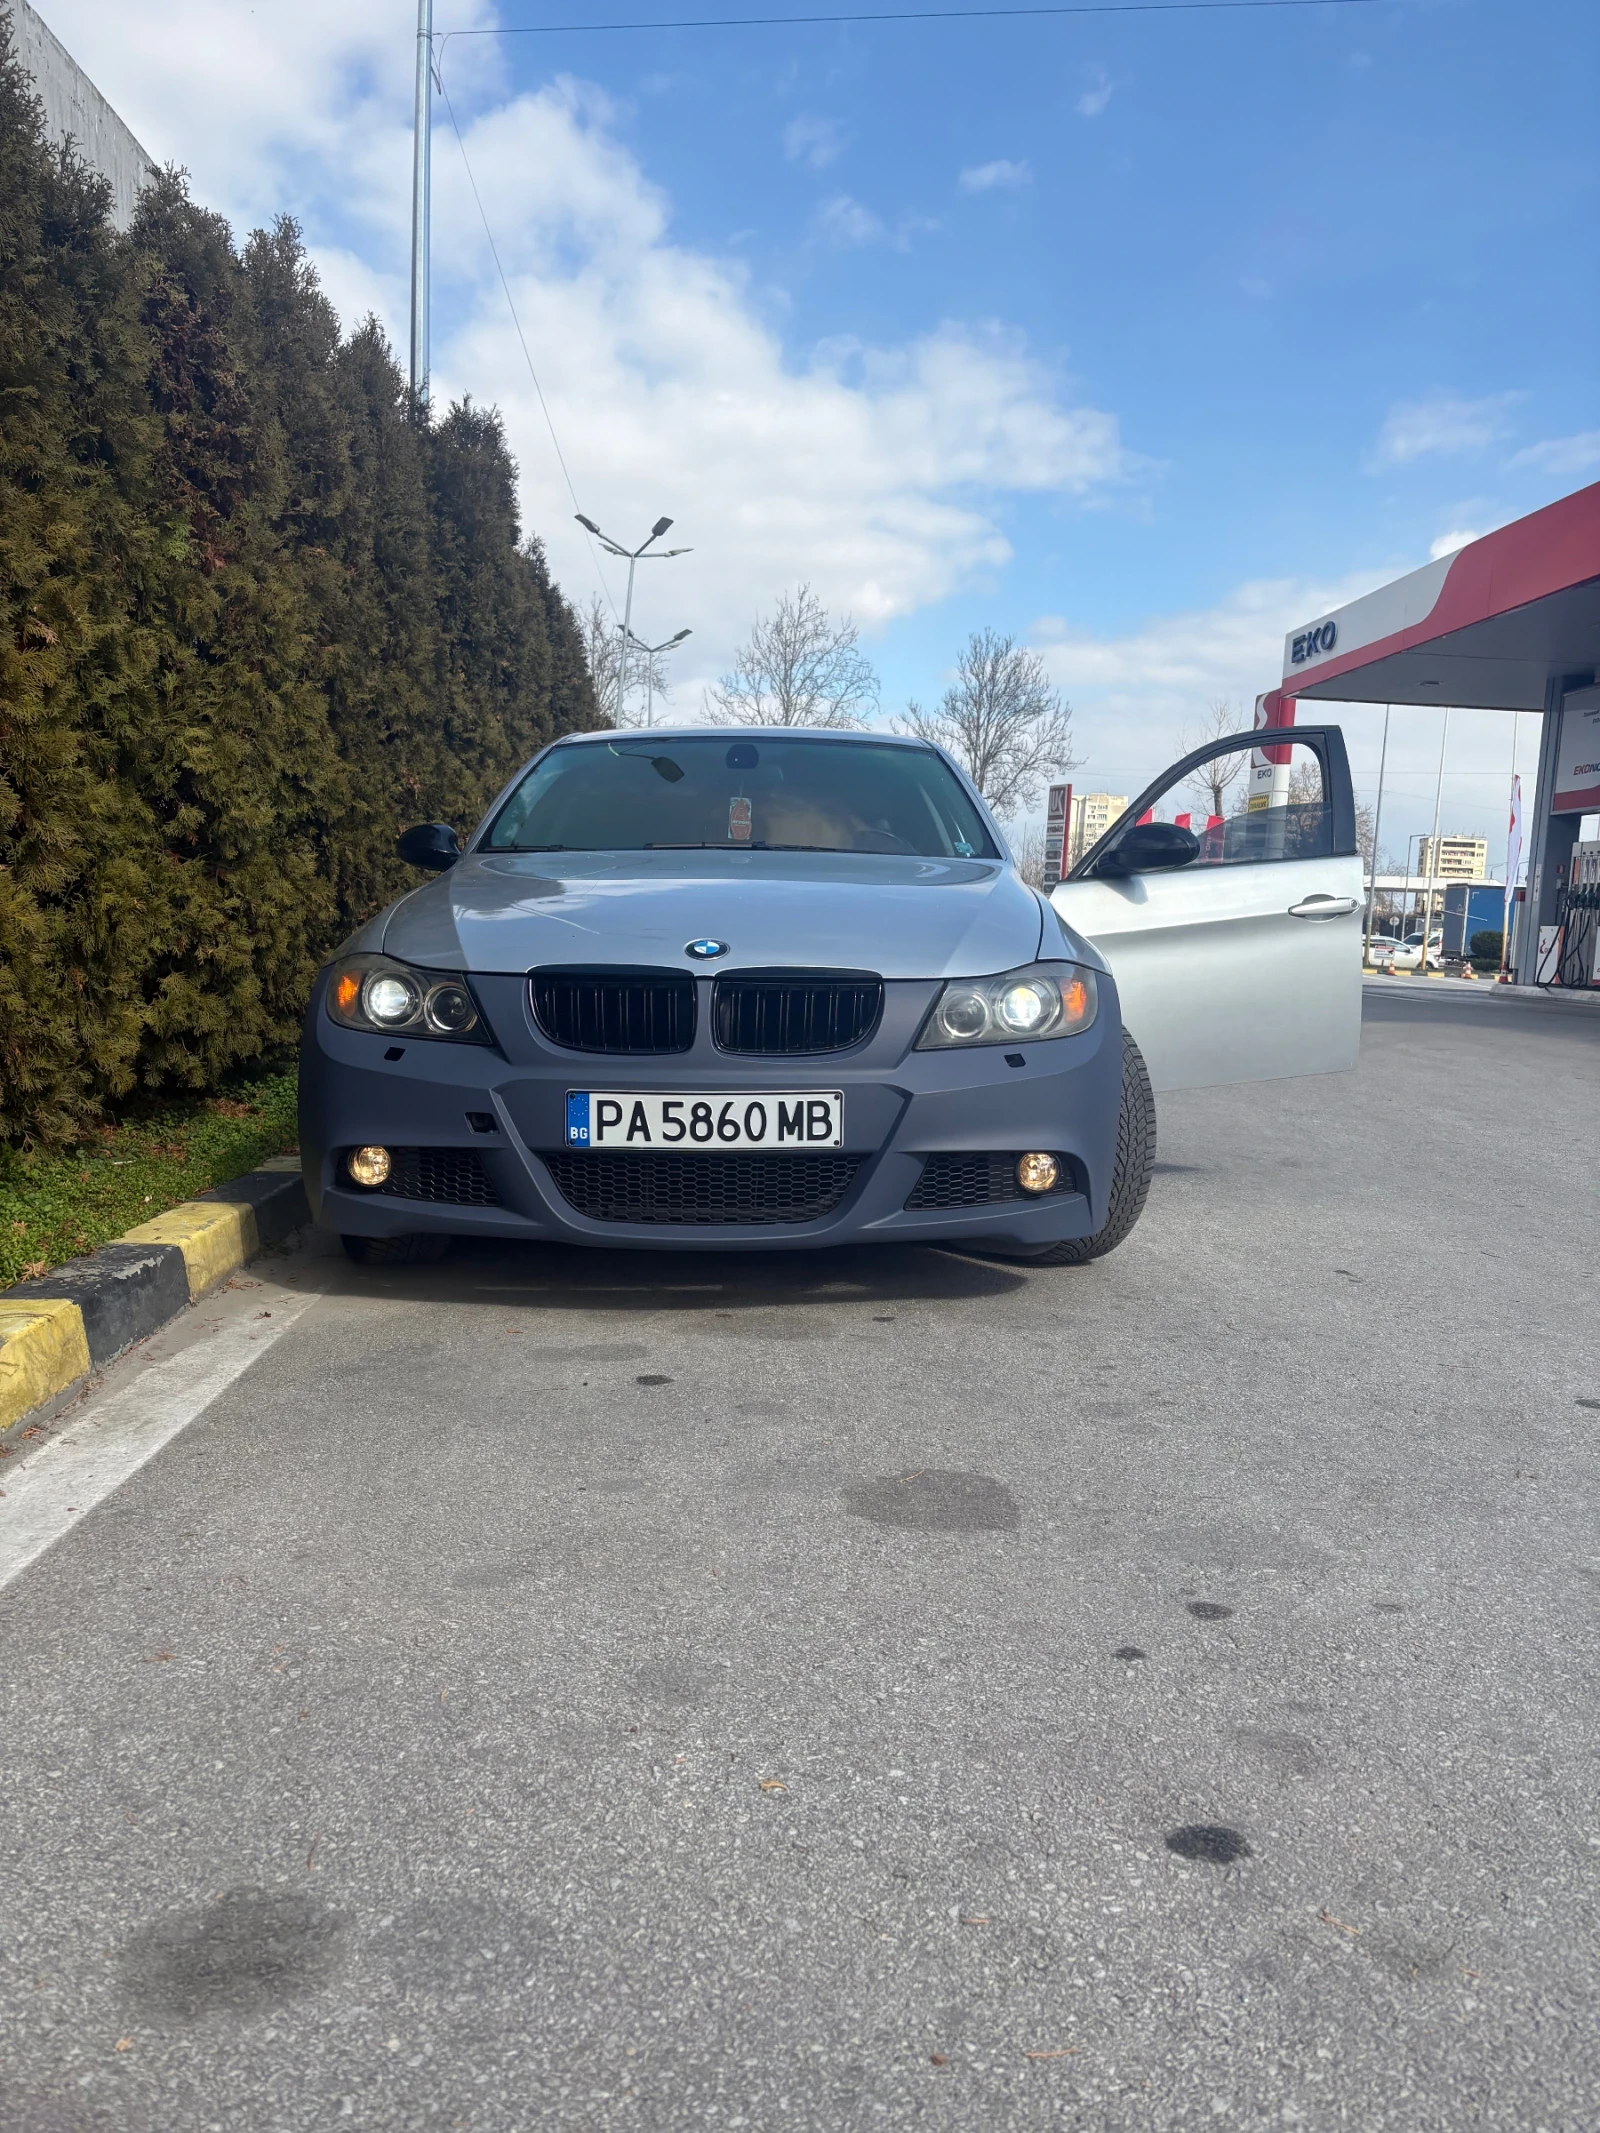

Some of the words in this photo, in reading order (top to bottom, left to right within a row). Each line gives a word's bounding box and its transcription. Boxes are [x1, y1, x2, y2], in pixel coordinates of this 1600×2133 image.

[1291, 620, 1337, 664] EKO
[1257, 768, 1272, 779] EKO
[570, 1127, 588, 1140] BG
[596, 1099, 652, 1142] PA
[662, 1101, 768, 1142] 5860
[778, 1100, 833, 1141] MB
